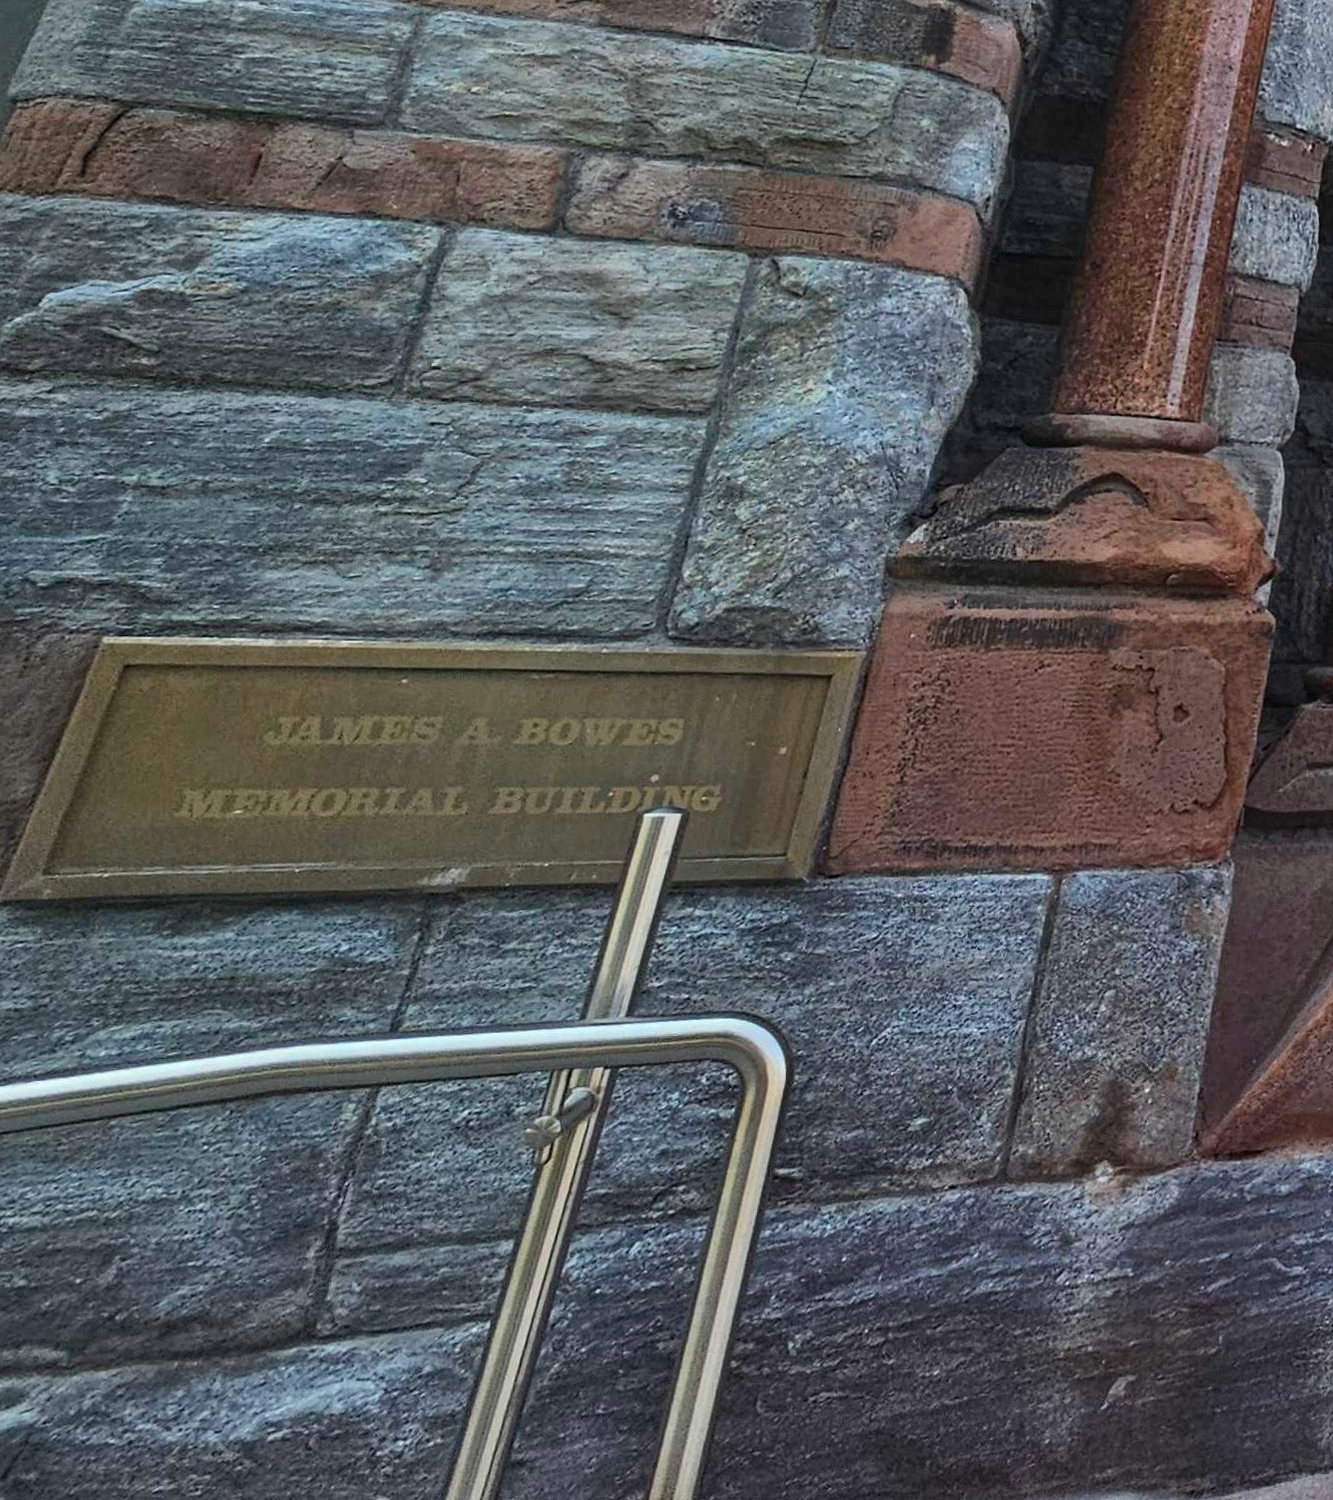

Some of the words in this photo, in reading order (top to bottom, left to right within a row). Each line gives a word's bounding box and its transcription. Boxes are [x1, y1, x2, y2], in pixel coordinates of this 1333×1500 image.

[262, 715, 444, 746] JAMES
[513, 717, 686, 746] BOWES
[173, 787, 469, 817] MEMORIAL
[488, 784, 722, 815] BUILDING
